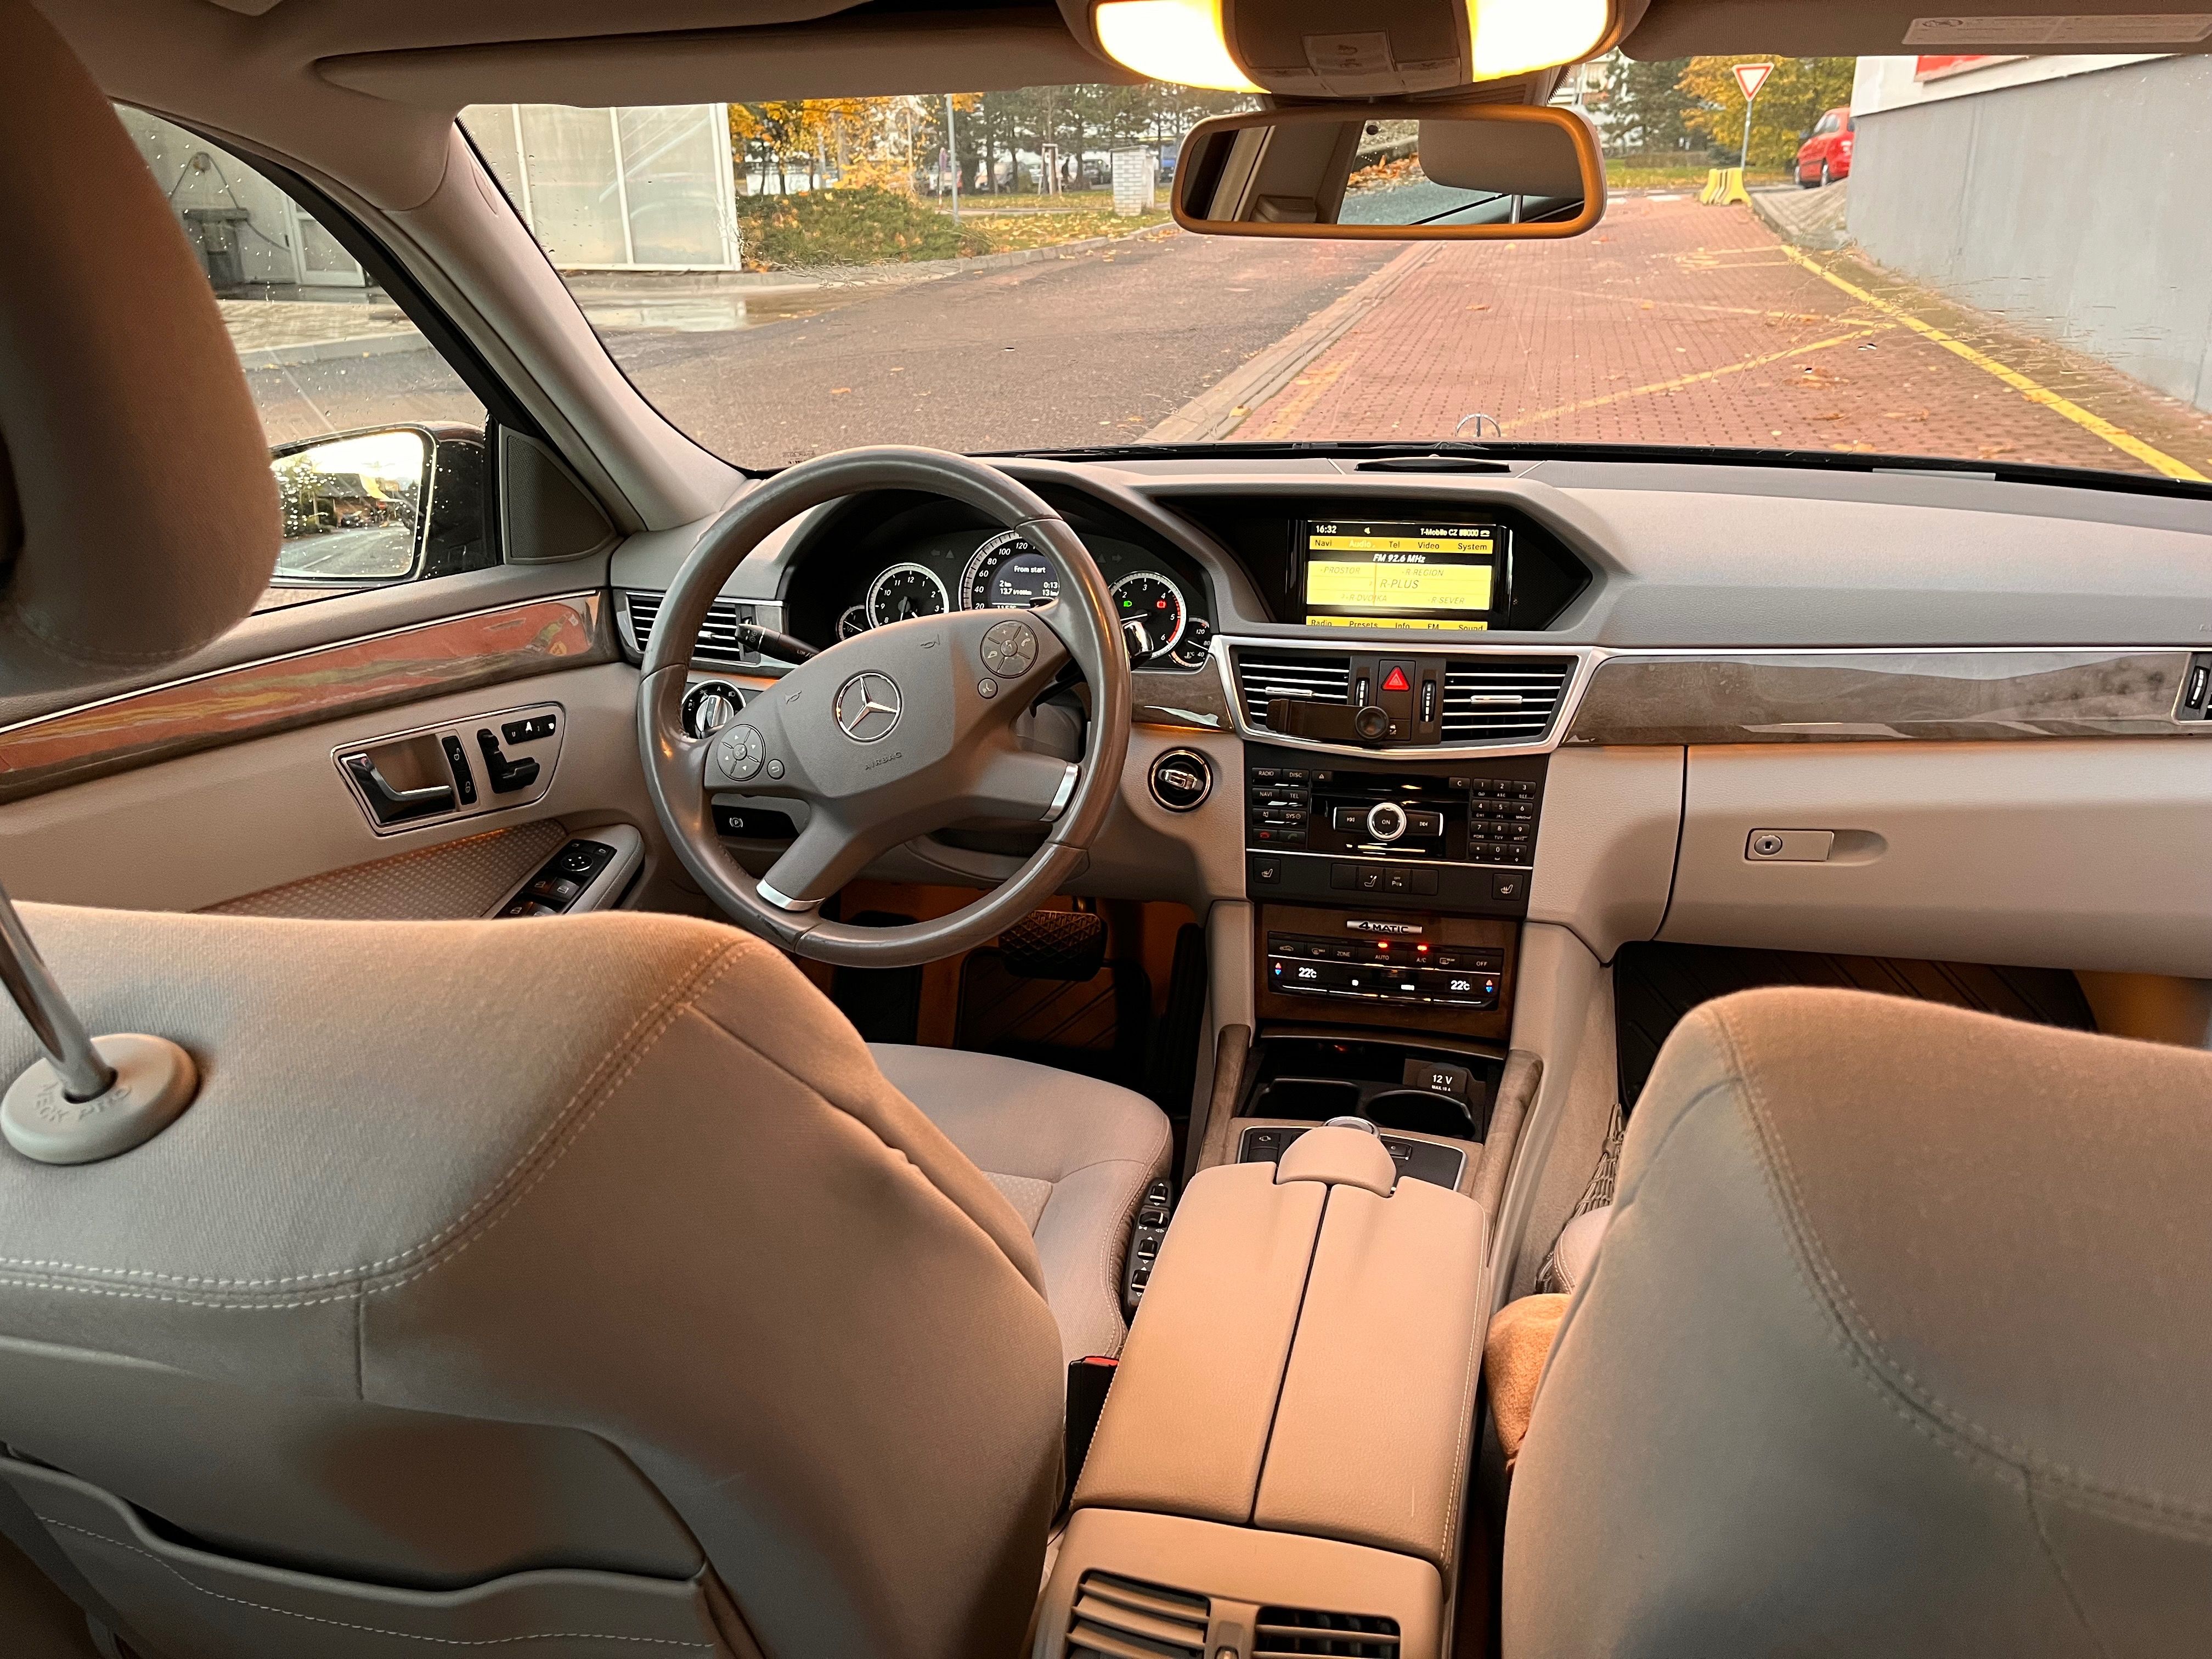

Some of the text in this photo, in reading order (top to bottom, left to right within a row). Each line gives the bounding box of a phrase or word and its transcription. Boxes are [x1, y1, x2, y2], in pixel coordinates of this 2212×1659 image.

[1316, 524, 1337, 534] 16:32
[1420, 528, 1448, 536] T-Mobile
[1348, 539, 1372, 548] Audio
[1458, 543, 1487, 552] System
[1373, 552, 1426, 563] FM 92.6 MHz
[999, 579, 1004, 588] 2
[1380, 579, 1419, 589] R-PLUS
[865, 752, 902, 770] AIRBAG
[1358, 921, 1409, 934] 4MATIC
[1432, 1074, 1453, 1085] 12 V
